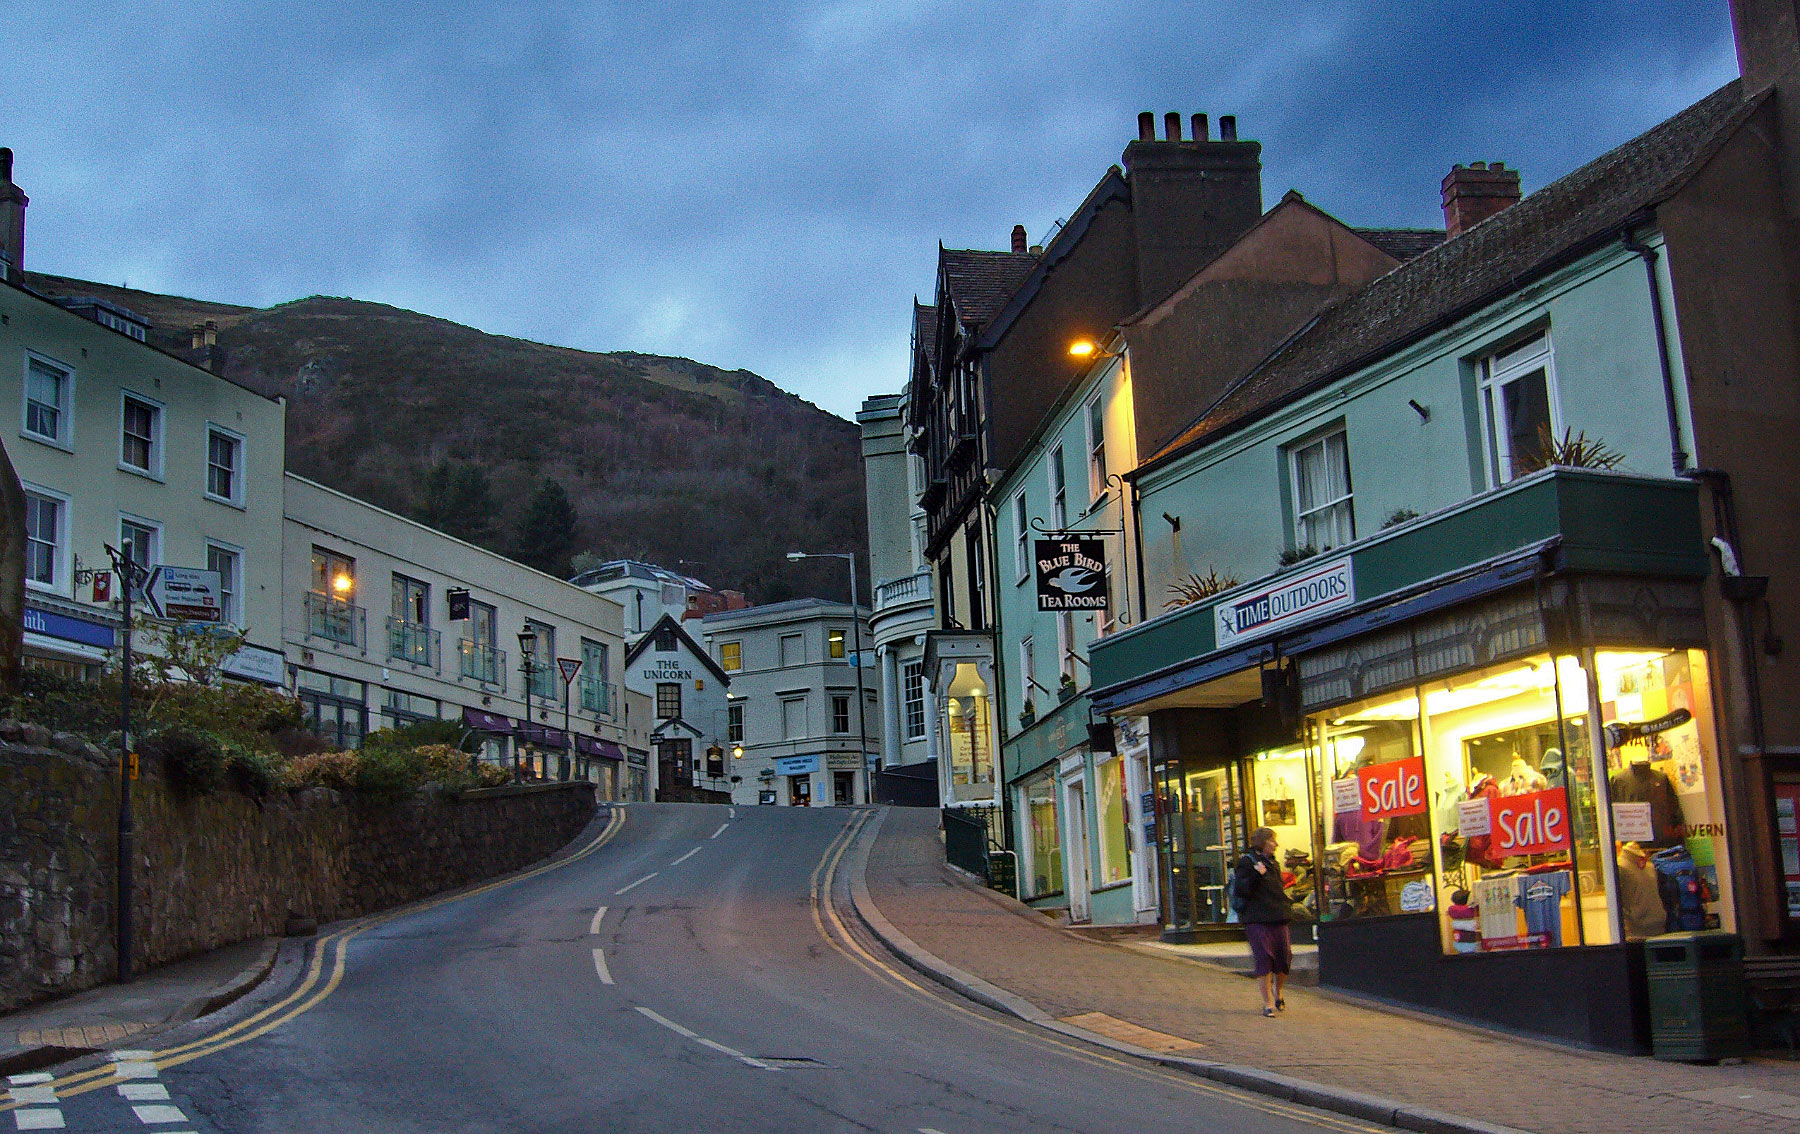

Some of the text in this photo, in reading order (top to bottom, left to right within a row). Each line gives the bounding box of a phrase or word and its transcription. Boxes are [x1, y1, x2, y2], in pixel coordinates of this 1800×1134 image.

[1060, 543, 1080, 553] THE
[1038, 553, 1103, 574] BLUE BIRD
[1039, 594, 1106, 608] TEA ROOMS
[1237, 572, 1347, 629] TIME OUTDOORS
[656, 660, 679, 670] THE
[643, 669, 692, 680] UNICORN
